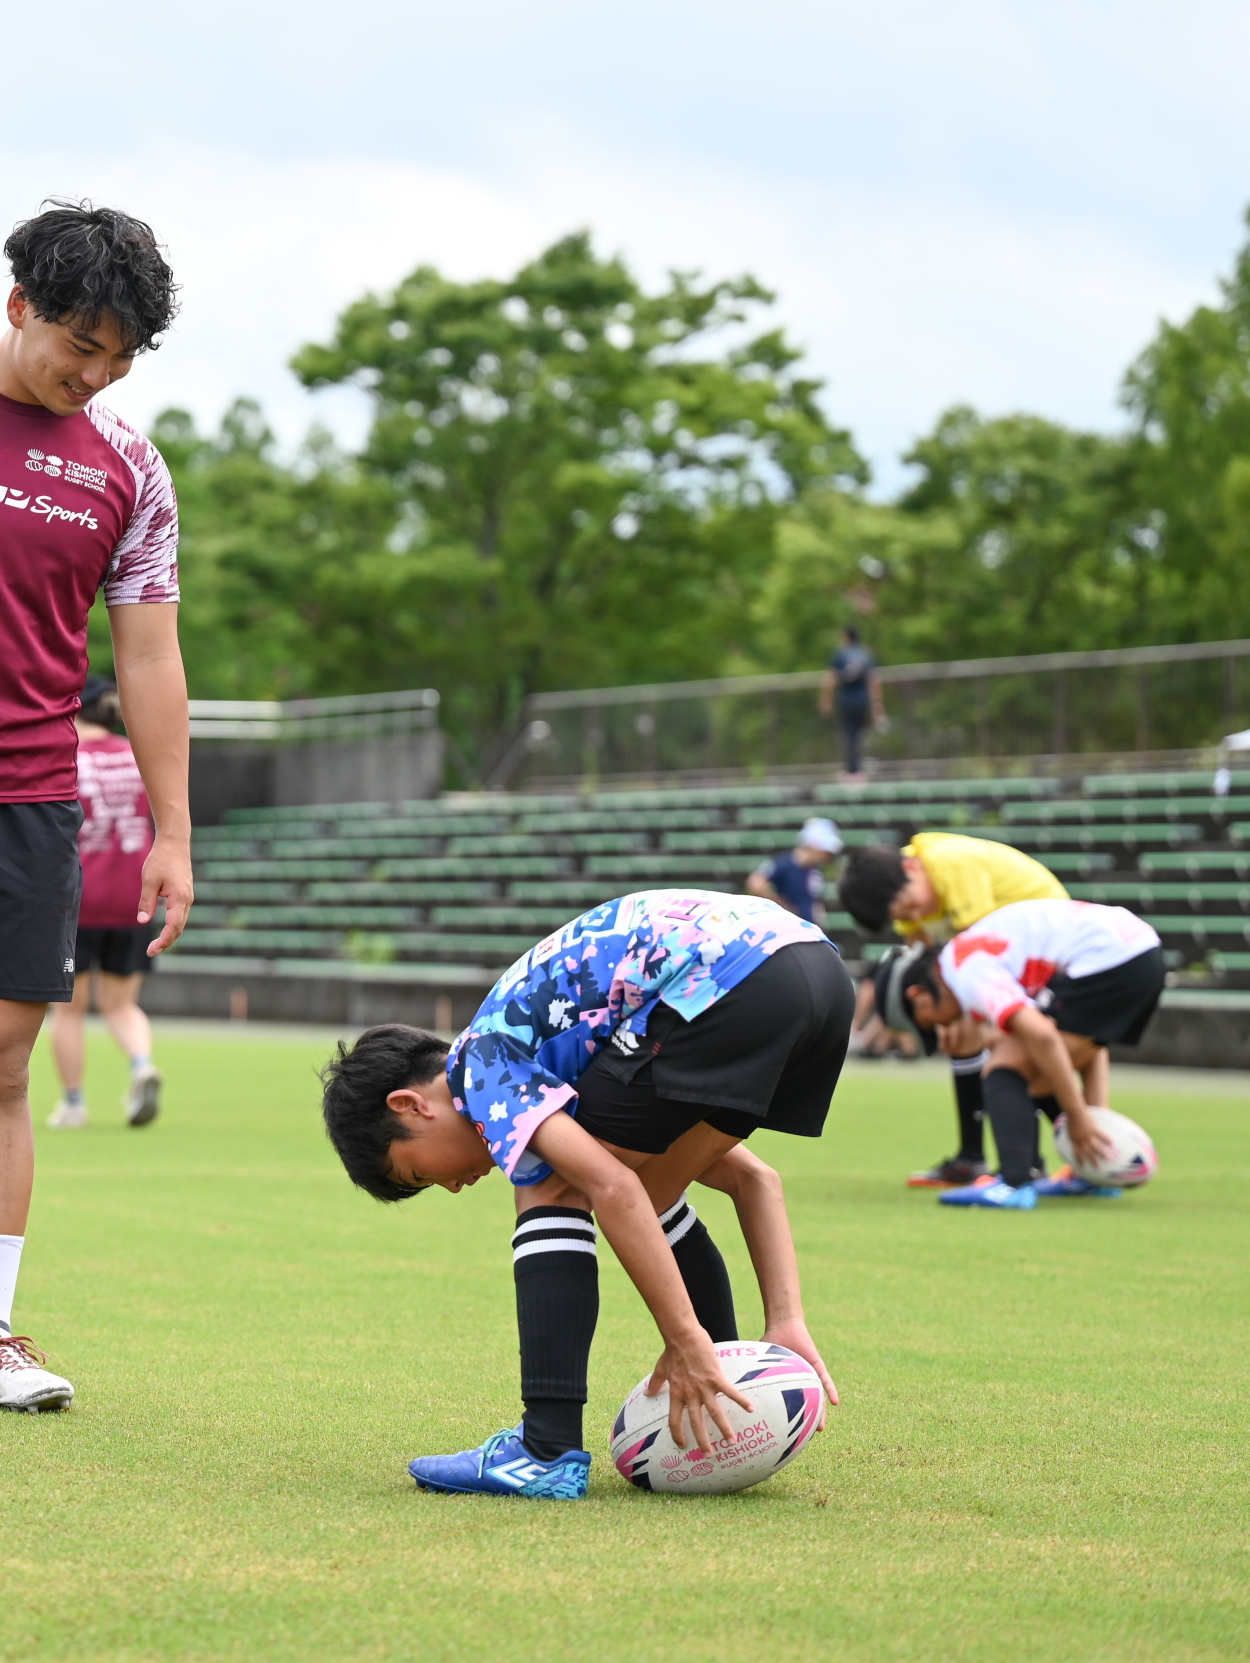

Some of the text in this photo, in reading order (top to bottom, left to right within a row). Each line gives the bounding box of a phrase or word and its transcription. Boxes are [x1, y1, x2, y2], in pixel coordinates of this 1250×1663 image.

[64, 475, 105, 493] RUGBY SCHOOL
[65, 468, 106, 487] KISHIOKA
[67, 460, 108, 479] TOMOKI
[30, 495, 98, 530] Sports
[711, 1419, 769, 1452] TOMOKI
[716, 1431, 776, 1462] KISHIOKA
[721, 1441, 779, 1470] RUGBY SCHOOL
